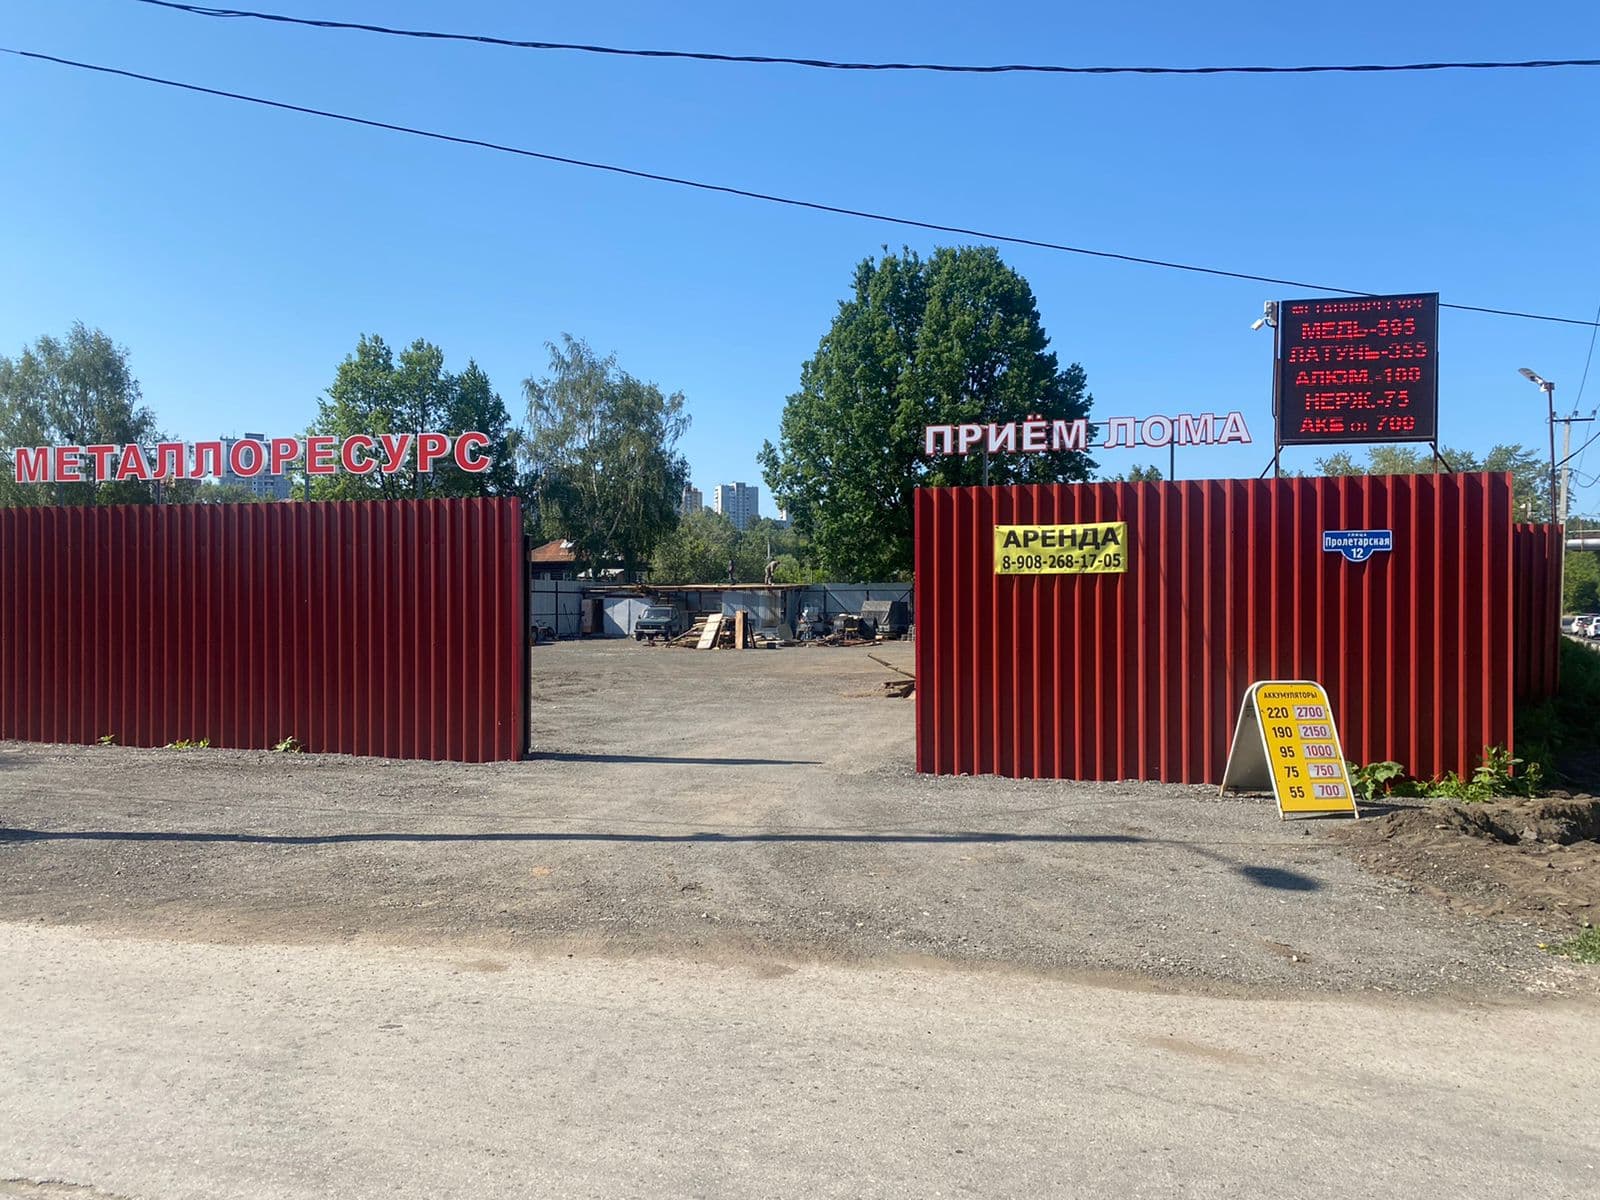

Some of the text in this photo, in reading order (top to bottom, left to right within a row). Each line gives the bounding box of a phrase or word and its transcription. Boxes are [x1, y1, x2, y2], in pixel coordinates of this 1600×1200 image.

[1300, 416, 1345, 433] АКБ
[1376, 415, 1416, 432] 700
[925, 411, 1252, 456] ПРИЁМ ЛОМА
[14, 431, 494, 484] МЕТАЛЛОРЕСУРС
[1002, 527, 1121, 551] АРЕНДА
[1325, 536, 1390, 548] Пролетарская
[1351, 547, 1364, 559] 12
[1002, 553, 1121, 569] 8-908-268-17-05
[1263, 691, 1318, 699] АККУМУЛЯТОРЫ
[1266, 706, 1323, 719] 220 2700
[1271, 725, 1327, 738] 190 2150
[1279, 745, 1332, 758] 95 1000
[1284, 765, 1334, 778] 75 750
[1289, 784, 1340, 799] 55 700
